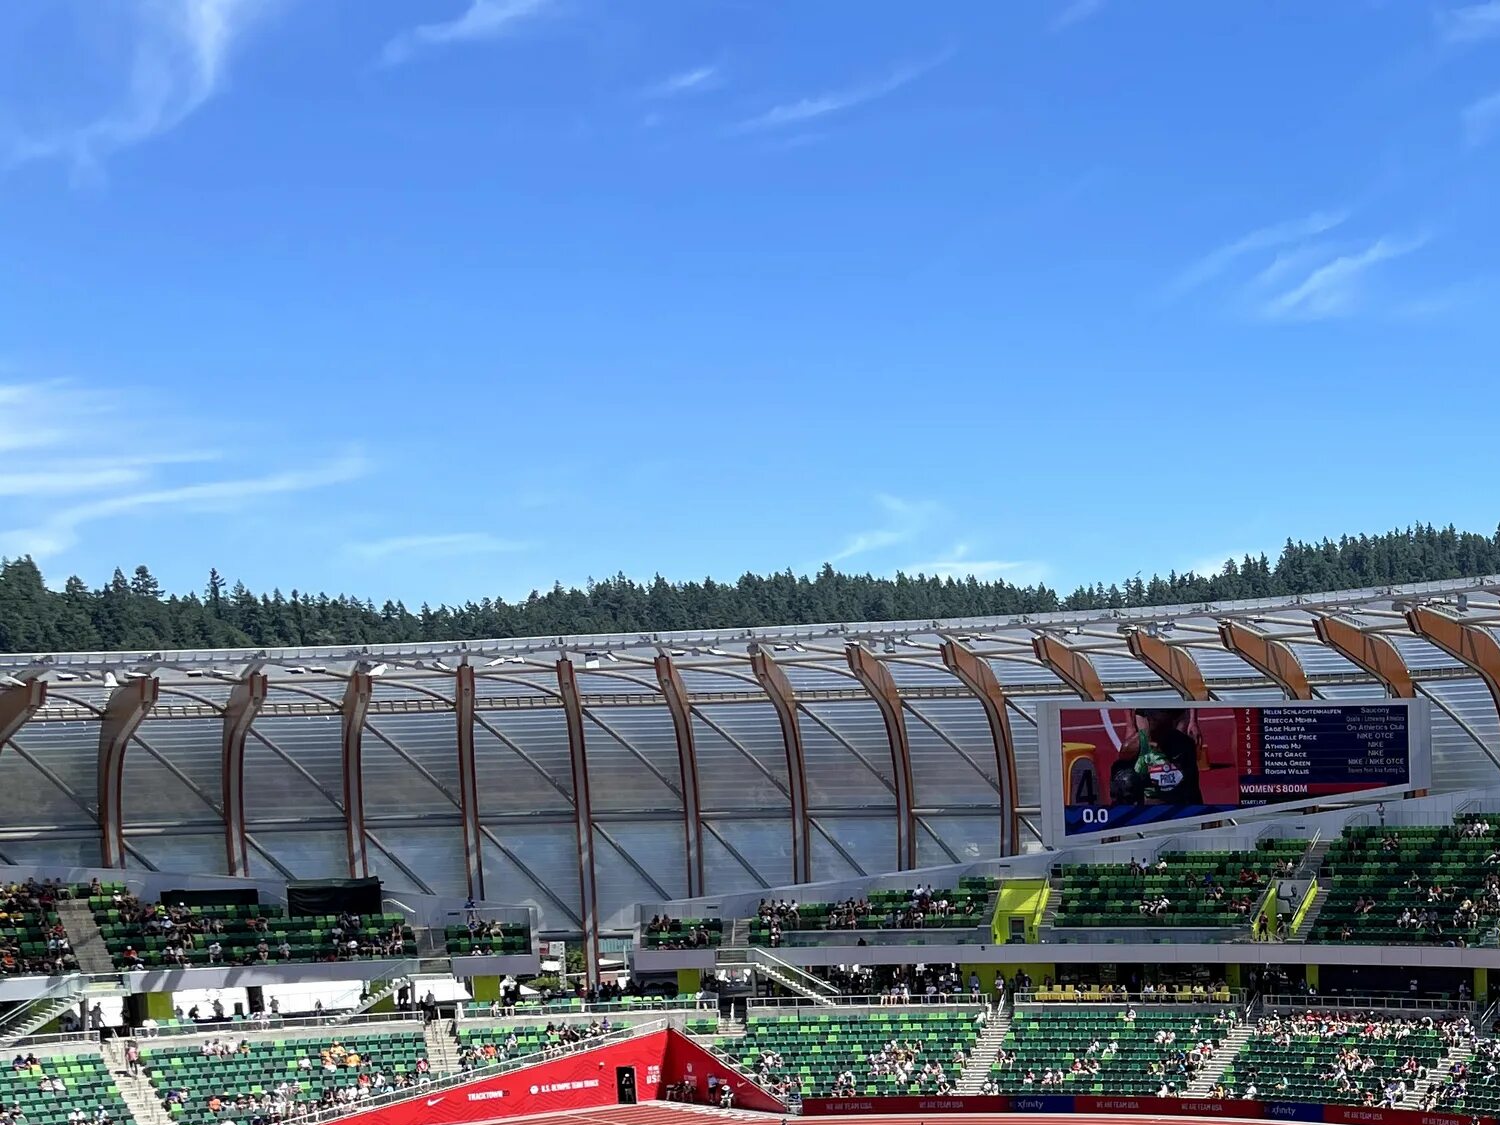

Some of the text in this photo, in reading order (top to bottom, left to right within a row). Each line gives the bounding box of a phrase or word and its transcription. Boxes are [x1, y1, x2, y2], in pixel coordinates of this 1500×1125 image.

[1160, 774, 1176, 784] PRICE
[1240, 785, 1281, 793] WOMEN'S
[1082, 808, 1108, 823] 0.0
[1017, 1101, 1044, 1110] xfinity
[1272, 1106, 1296, 1117] xfinity
